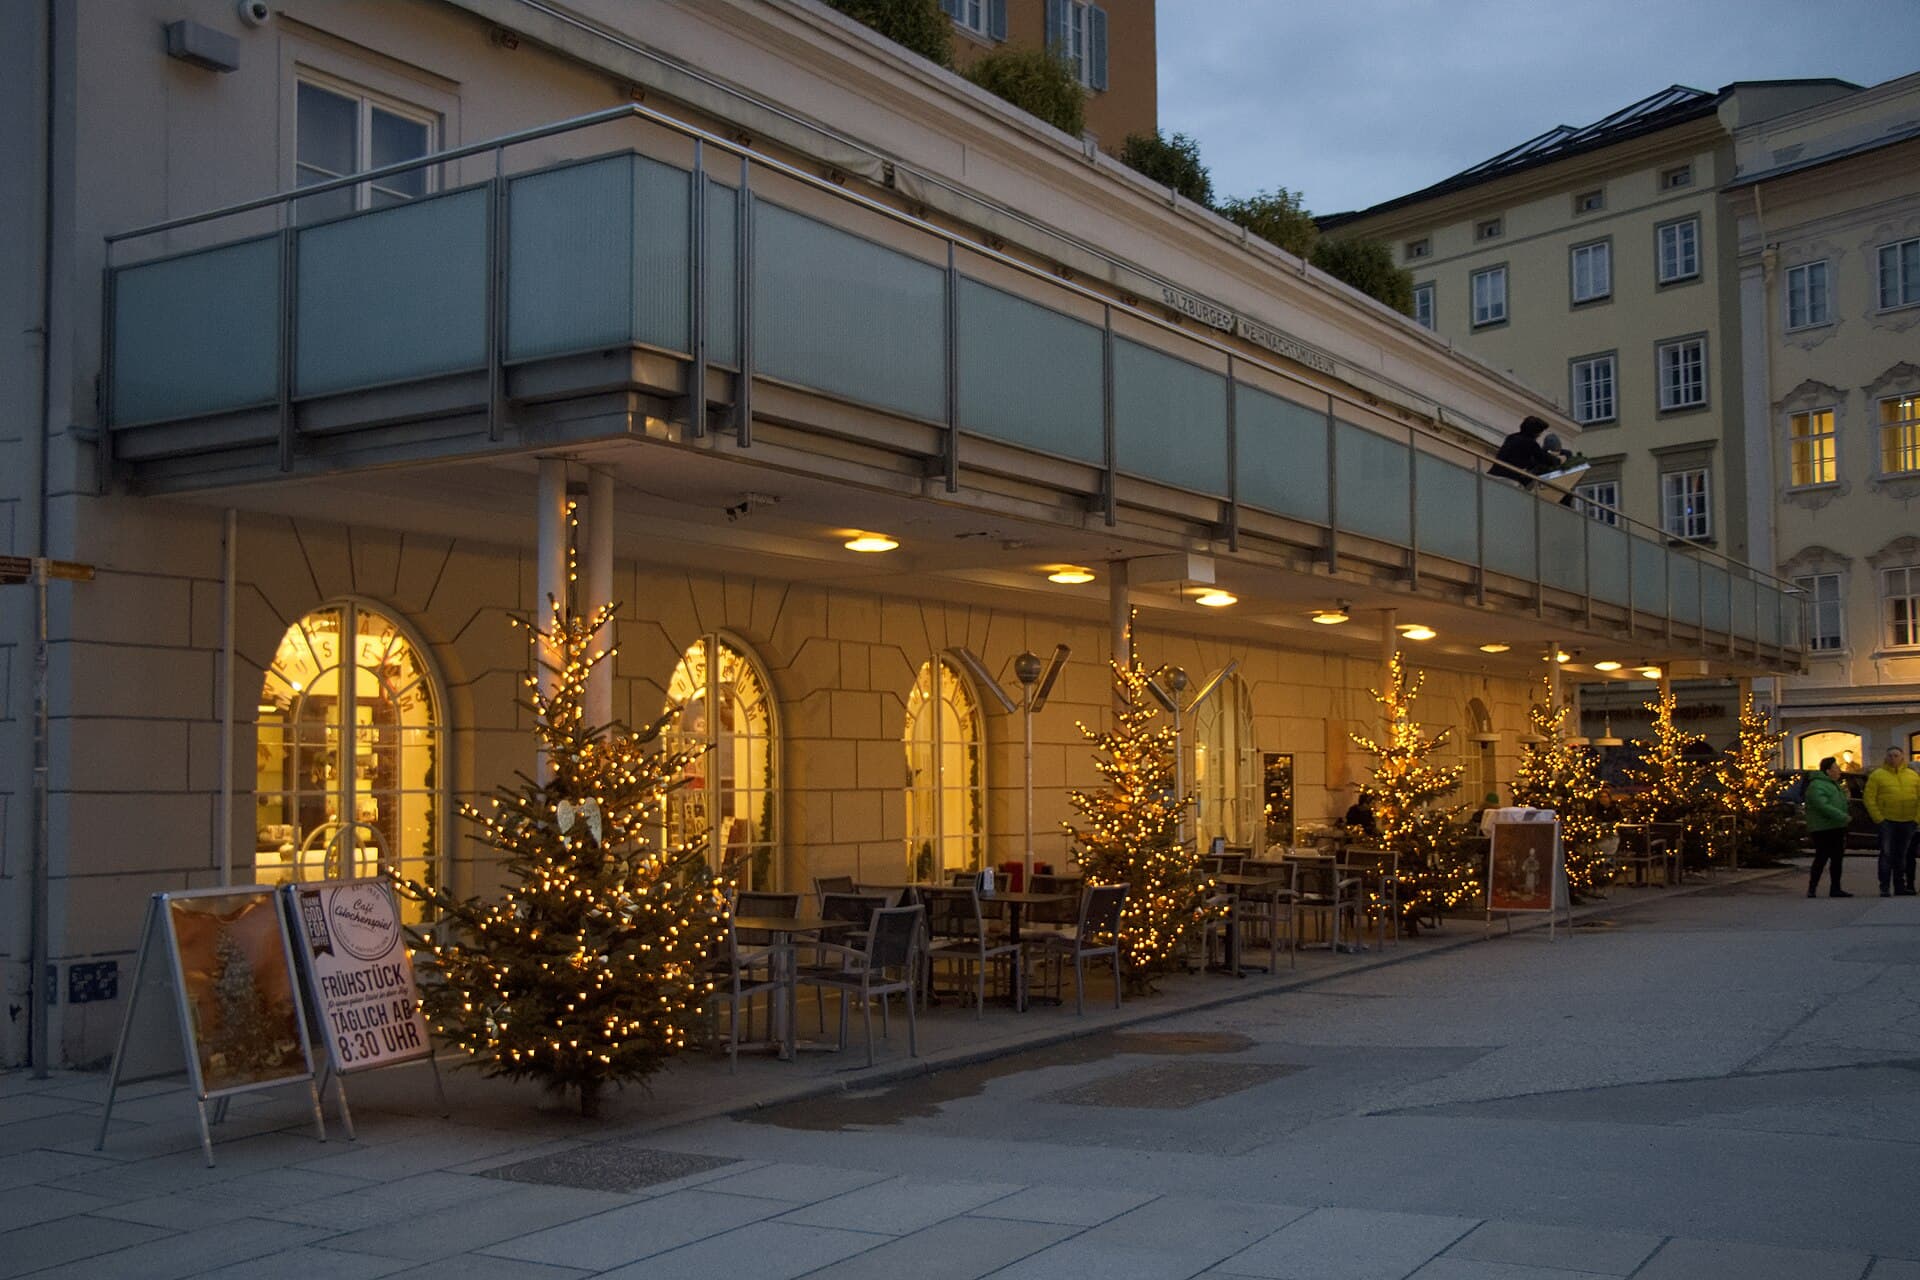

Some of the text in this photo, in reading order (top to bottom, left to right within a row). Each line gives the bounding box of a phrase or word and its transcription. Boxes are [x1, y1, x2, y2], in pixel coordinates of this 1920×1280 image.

[1162, 288, 1232, 329] SALZBURGER
[305, 906, 323, 921] GOD
[308, 921, 328, 937] FOR
[321, 963, 405, 999] FRÜHSTÜCK
[331, 999, 412, 1034] TÄGLICH AB
[338, 1022, 421, 1062] 8:30 UHR
